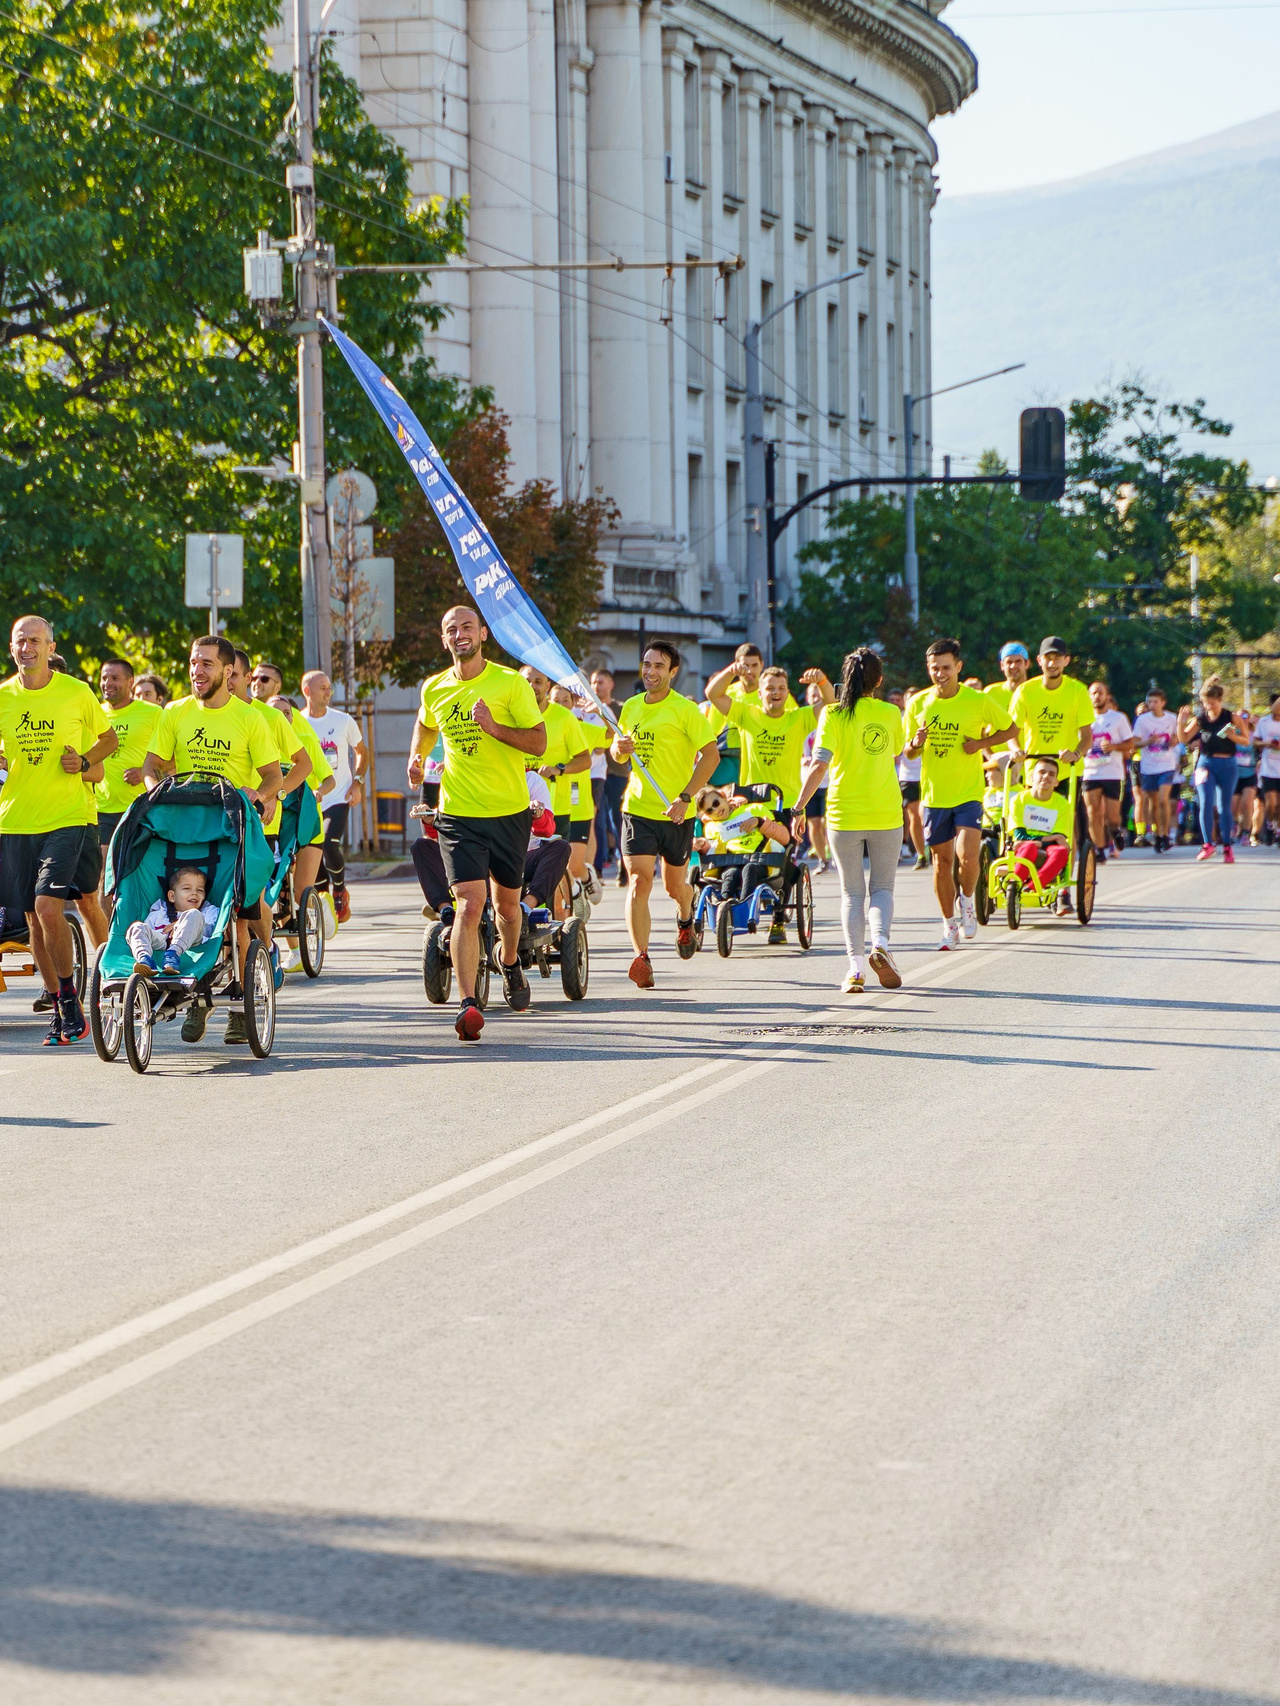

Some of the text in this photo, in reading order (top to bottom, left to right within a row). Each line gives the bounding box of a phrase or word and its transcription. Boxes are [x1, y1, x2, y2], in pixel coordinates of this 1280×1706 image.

[30, 720, 54, 730] UN
[638, 732, 654, 740] UN
[204, 738, 231, 750] UN
